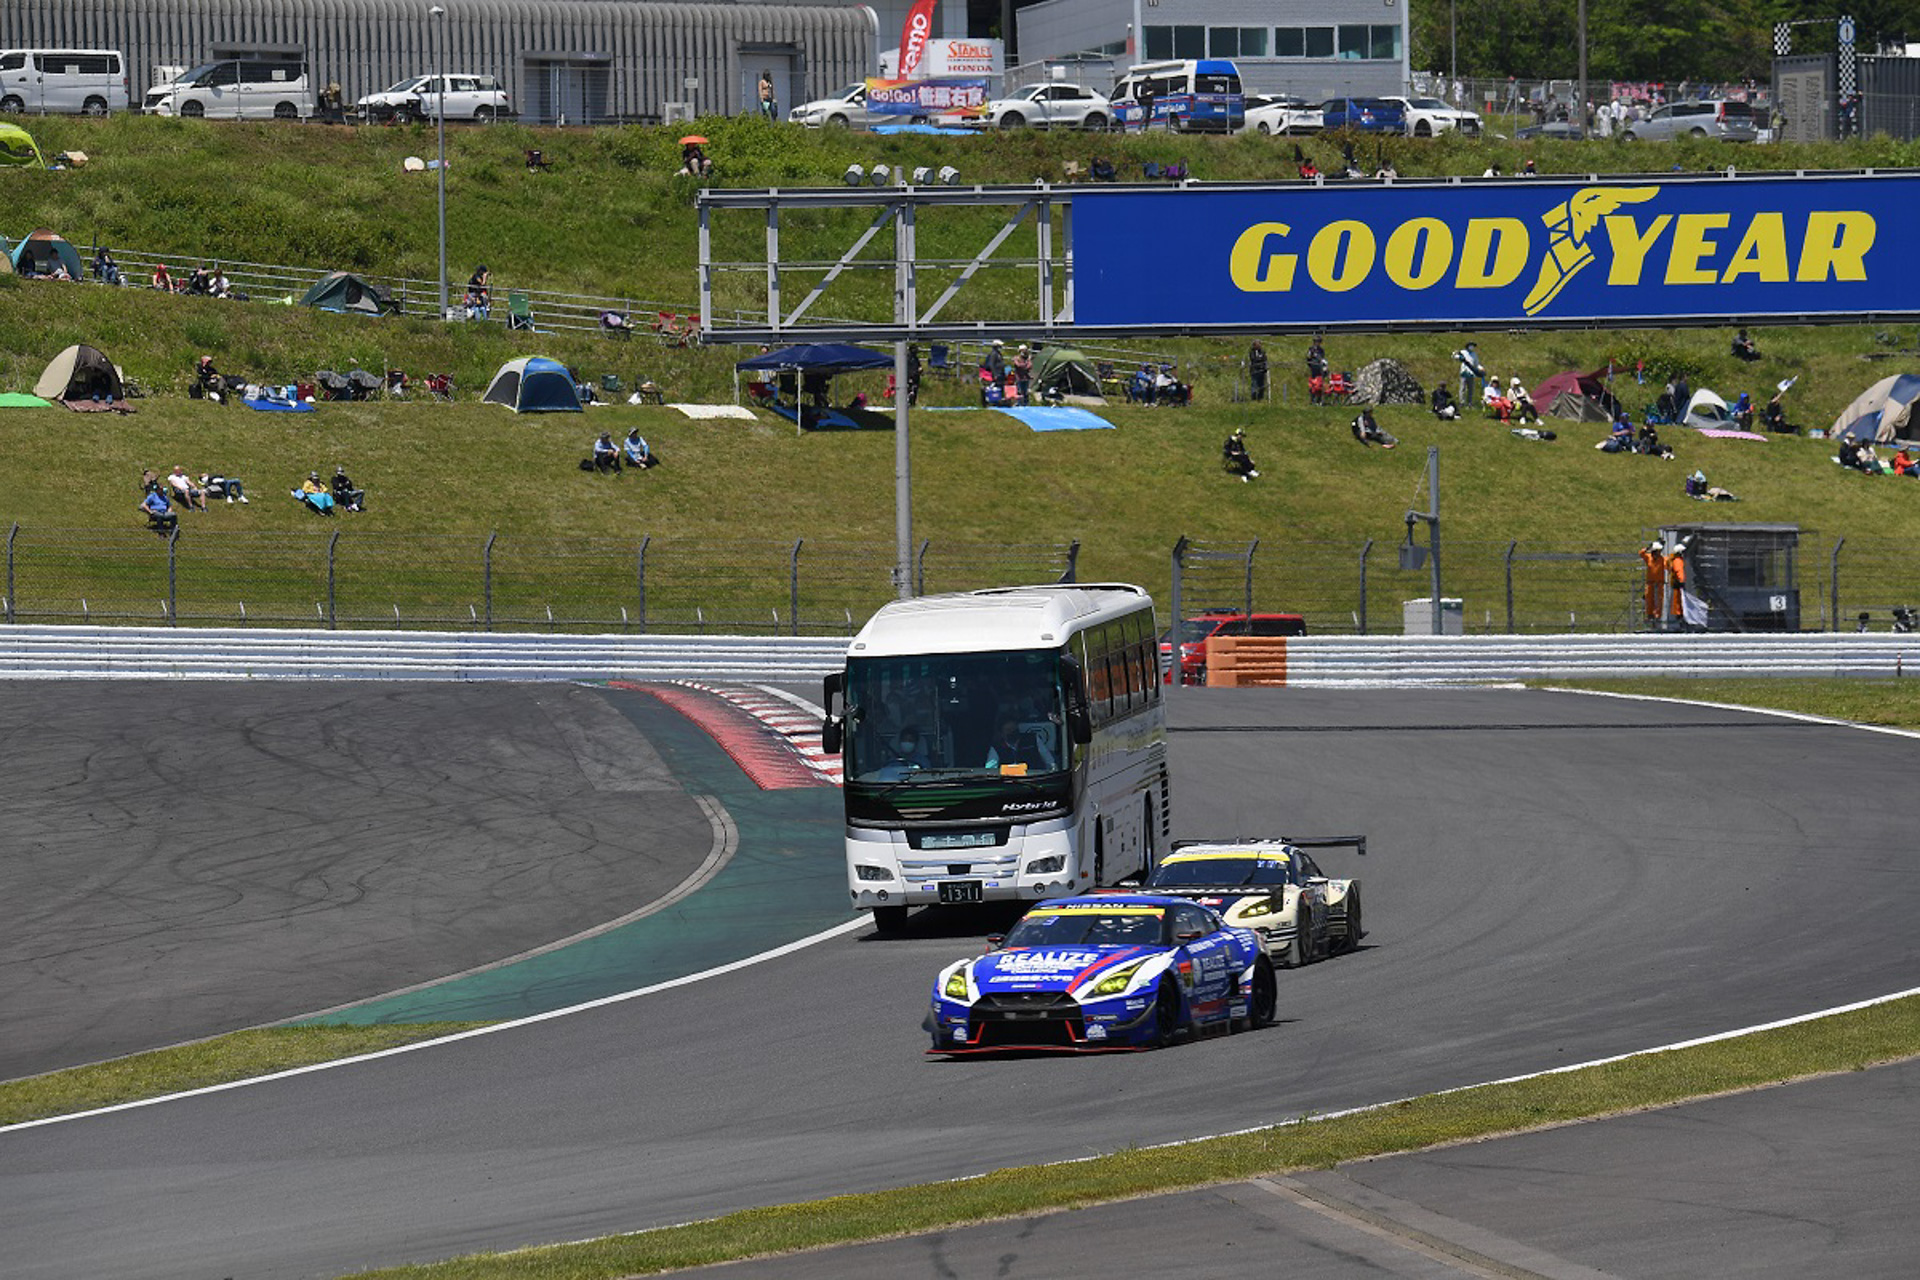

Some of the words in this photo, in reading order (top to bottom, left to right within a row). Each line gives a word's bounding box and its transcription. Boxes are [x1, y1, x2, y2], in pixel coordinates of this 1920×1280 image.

[948, 64, 993, 72] HONDA
[870, 89, 916, 102] Go!Go!
[1001, 800, 1057, 811] Hybrid
[1000, 951, 1098, 964] REALIZE
